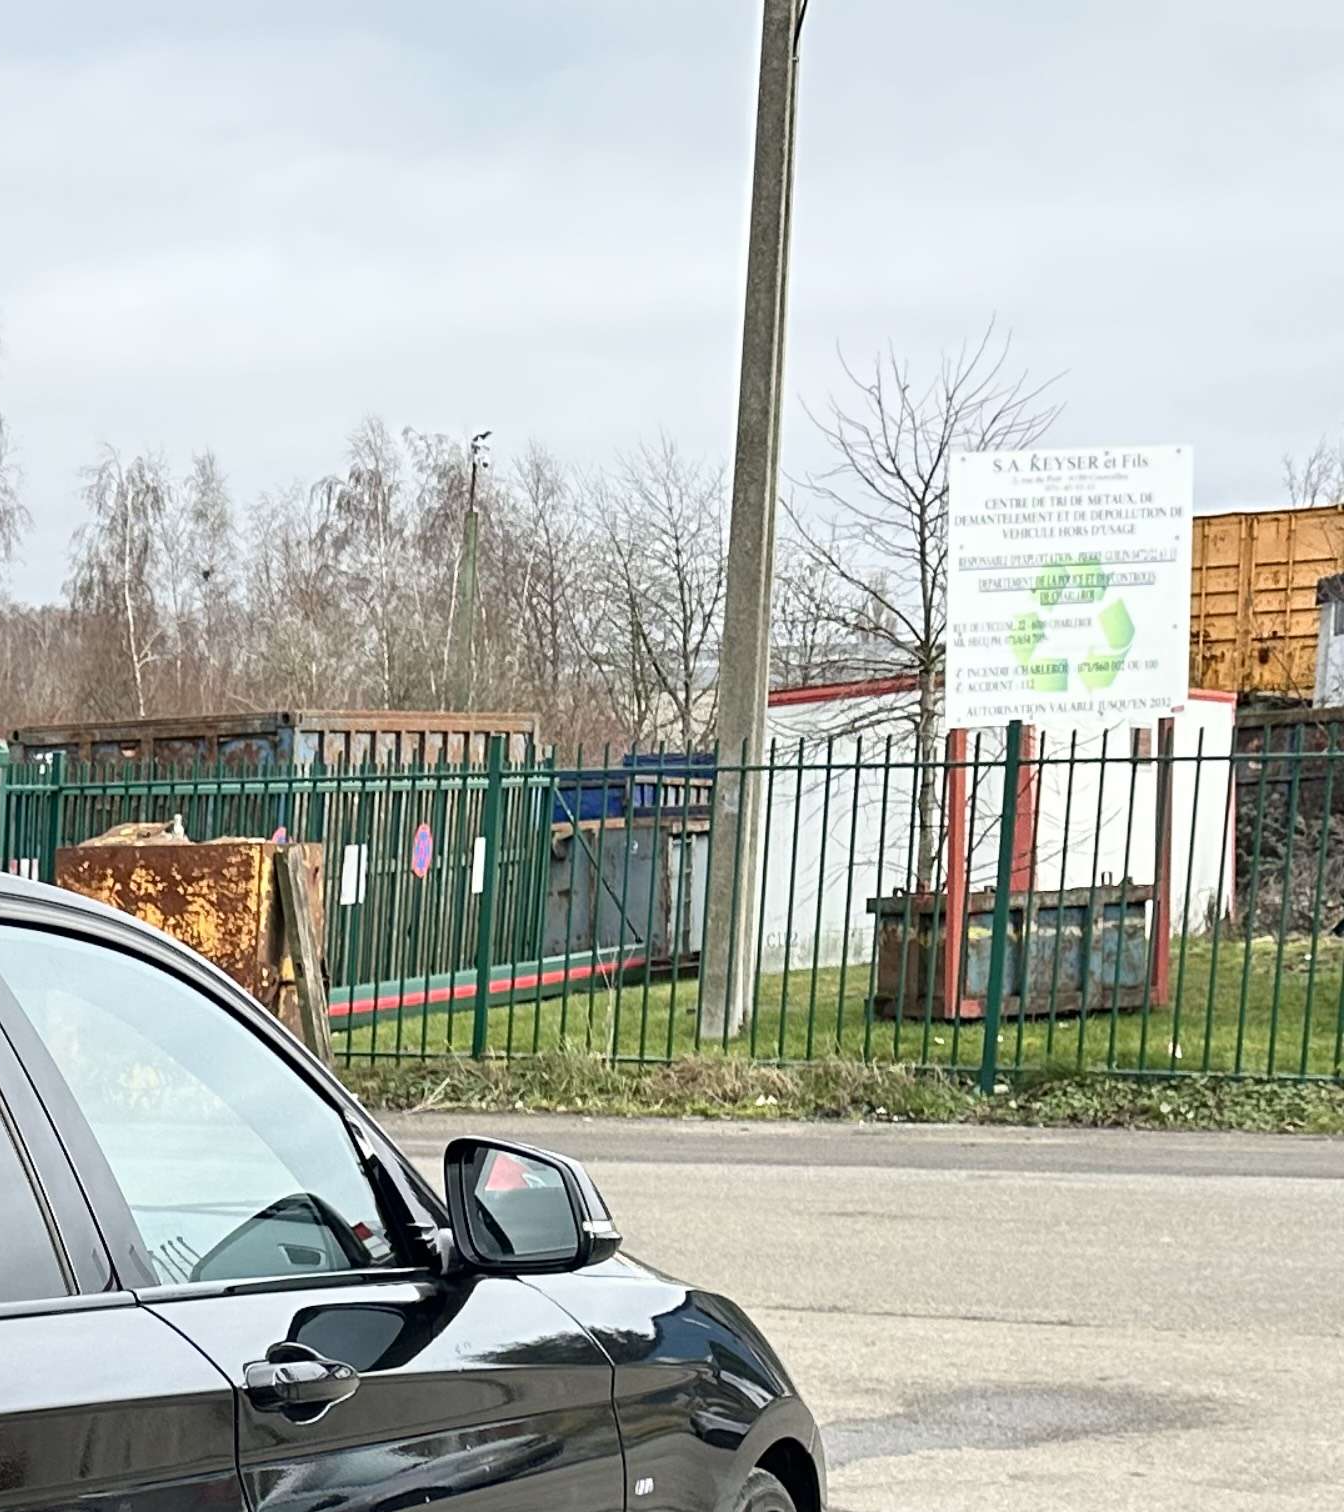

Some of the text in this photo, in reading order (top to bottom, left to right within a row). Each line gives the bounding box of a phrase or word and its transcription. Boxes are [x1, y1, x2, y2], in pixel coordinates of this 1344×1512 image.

[1030, 457, 1098, 472] KEYSER
[1104, 457, 1116, 469] et
[1122, 454, 1149, 468] Fils
[985, 497, 1028, 510] CENTRE
[1032, 497, 1046, 509] DE
[1050, 496, 1067, 507] TRI
[1070, 495, 1083, 506] DE
[1140, 492, 1153, 503] DE
[1057, 511, 1069, 522] ET
[1073, 510, 1086, 521] DE
[1170, 506, 1182, 517] DE
[1059, 526, 1089, 537] HORS
